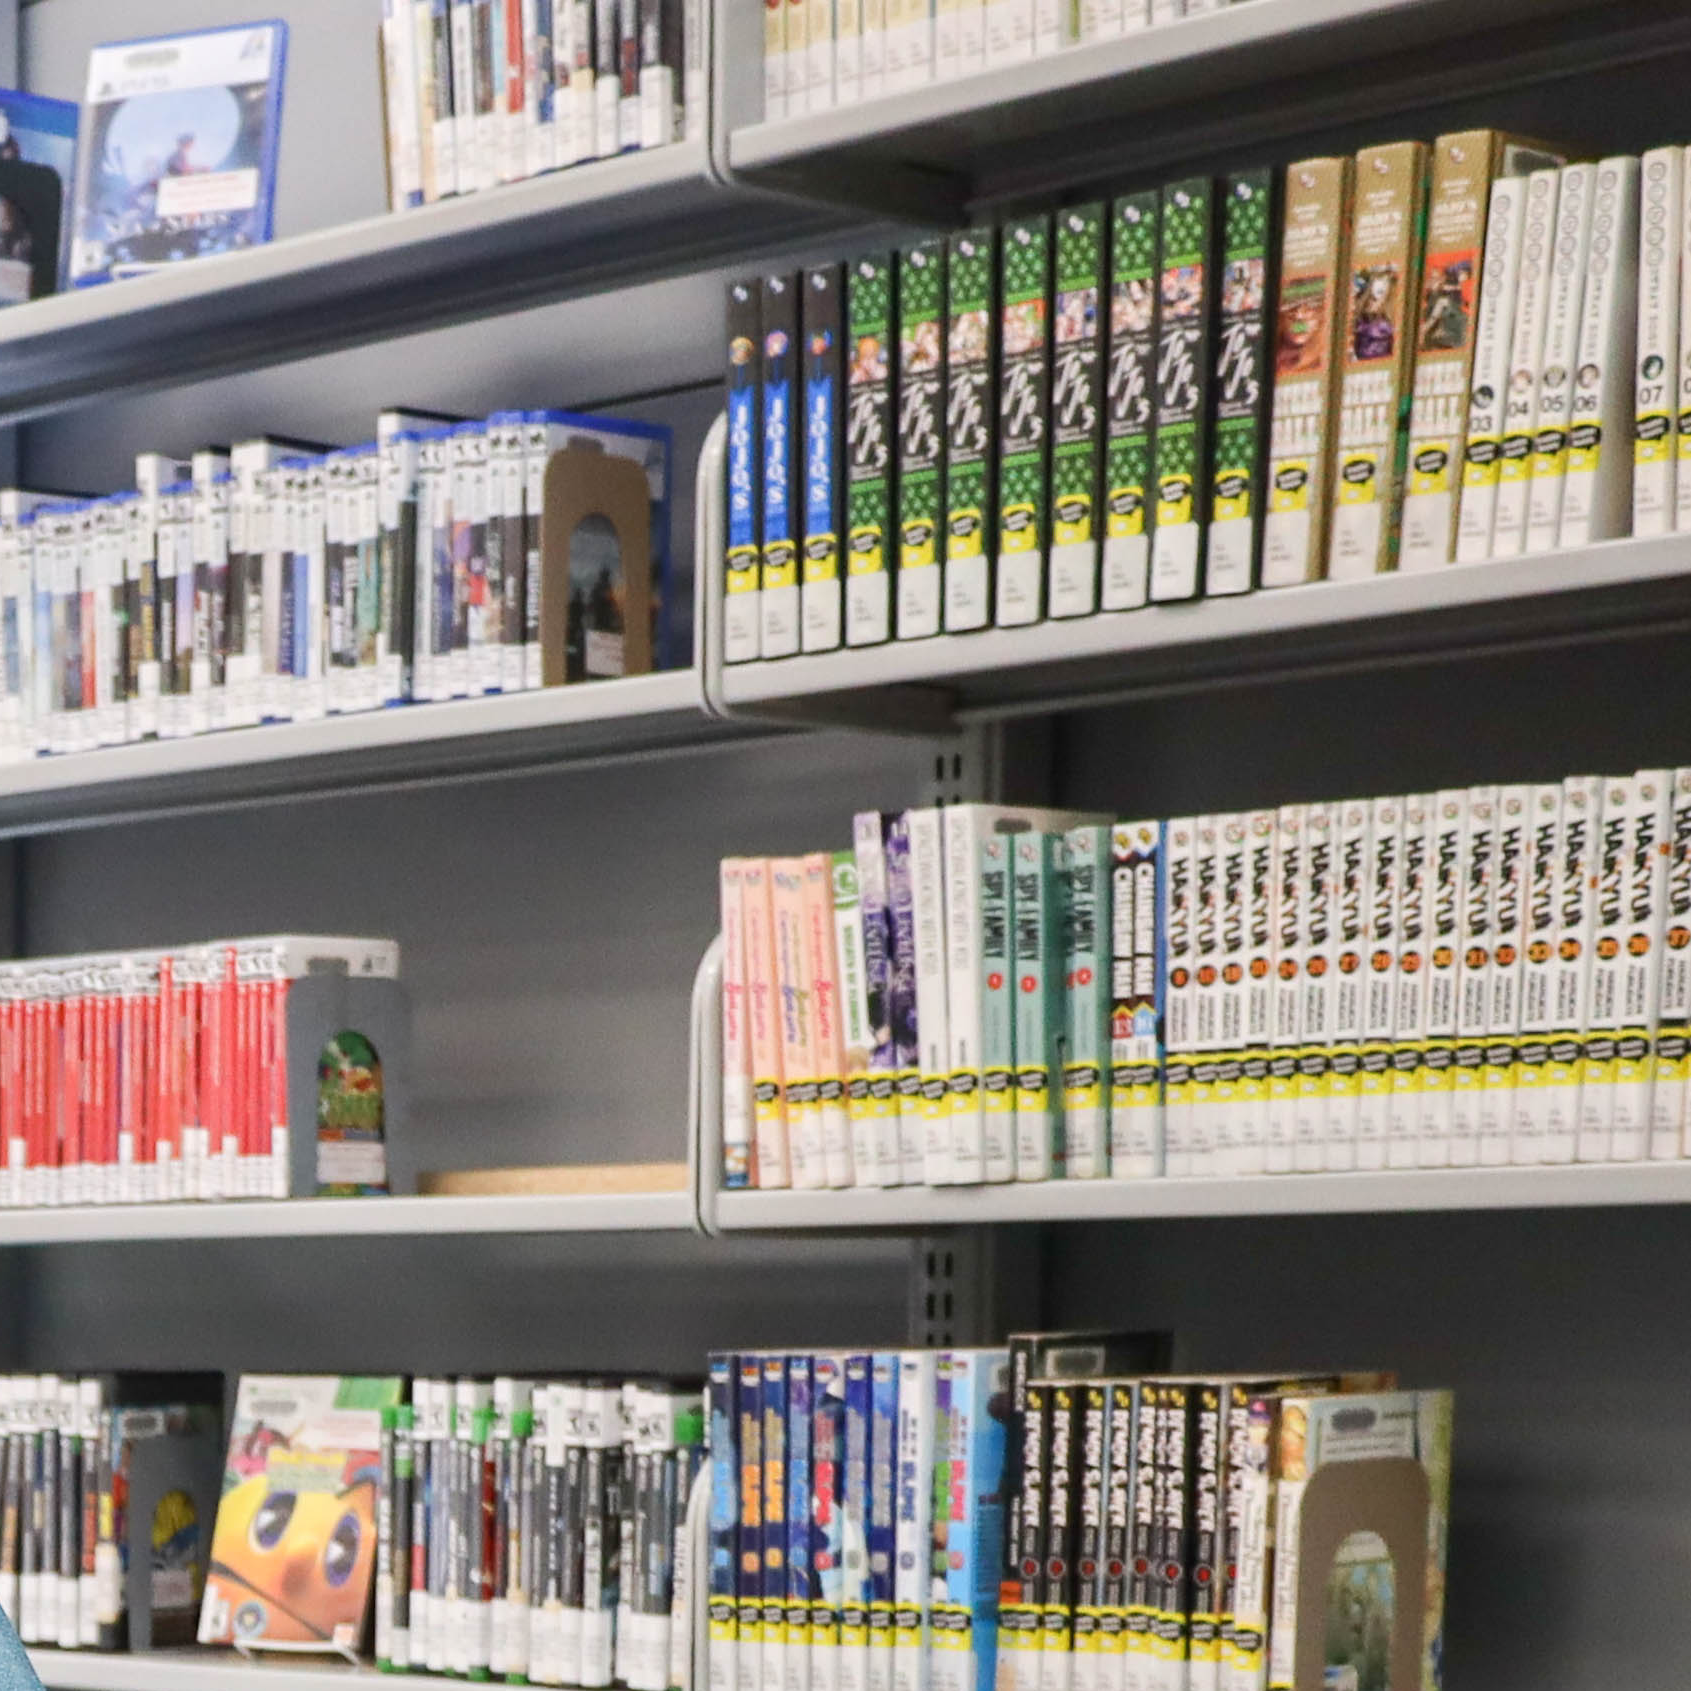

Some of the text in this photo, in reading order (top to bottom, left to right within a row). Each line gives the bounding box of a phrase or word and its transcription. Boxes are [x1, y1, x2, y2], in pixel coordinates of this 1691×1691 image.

[1640, 387, 1663, 405] 07
[1507, 402, 1529, 418] 04
[1541, 398, 1564, 413] 05
[1573, 398, 1598, 413] 06
[1470, 416, 1493, 433] 03
[1114, 961, 1133, 999] MAN
[1135, 957, 1155, 996] MAN
